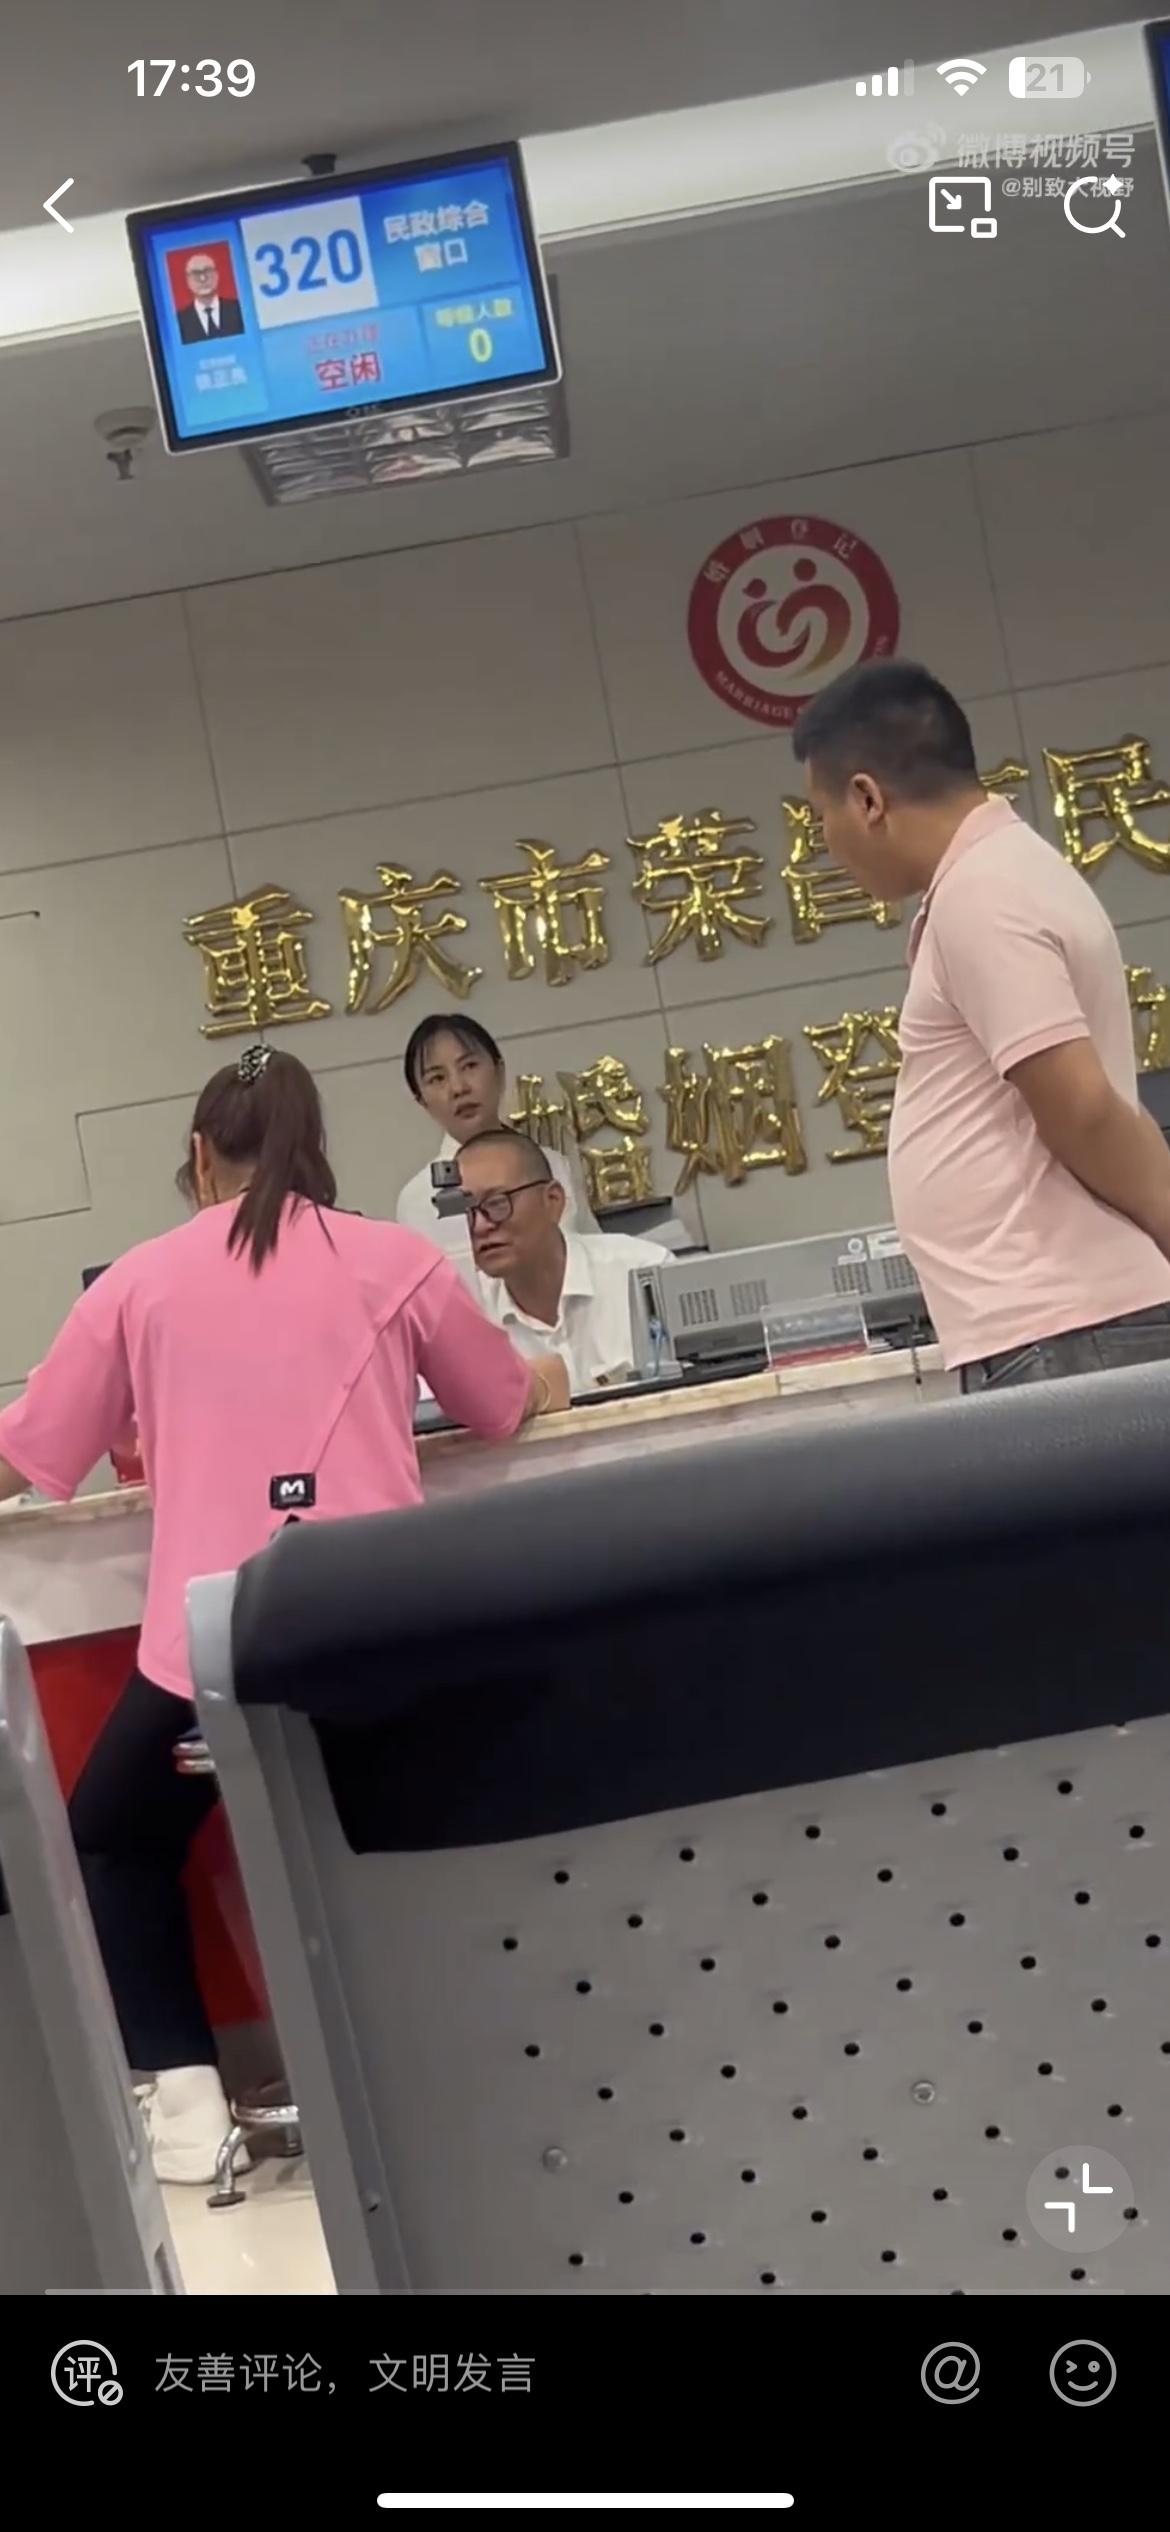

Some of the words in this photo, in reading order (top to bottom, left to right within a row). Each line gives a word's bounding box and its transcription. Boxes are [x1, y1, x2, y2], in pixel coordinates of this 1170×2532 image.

[383, 199, 491, 244] 民政综合
[254, 228, 364, 298] 320
[414, 238, 470, 273] 窗口
[468, 327, 494, 364] 0
[315, 351, 383, 392] 空闲
